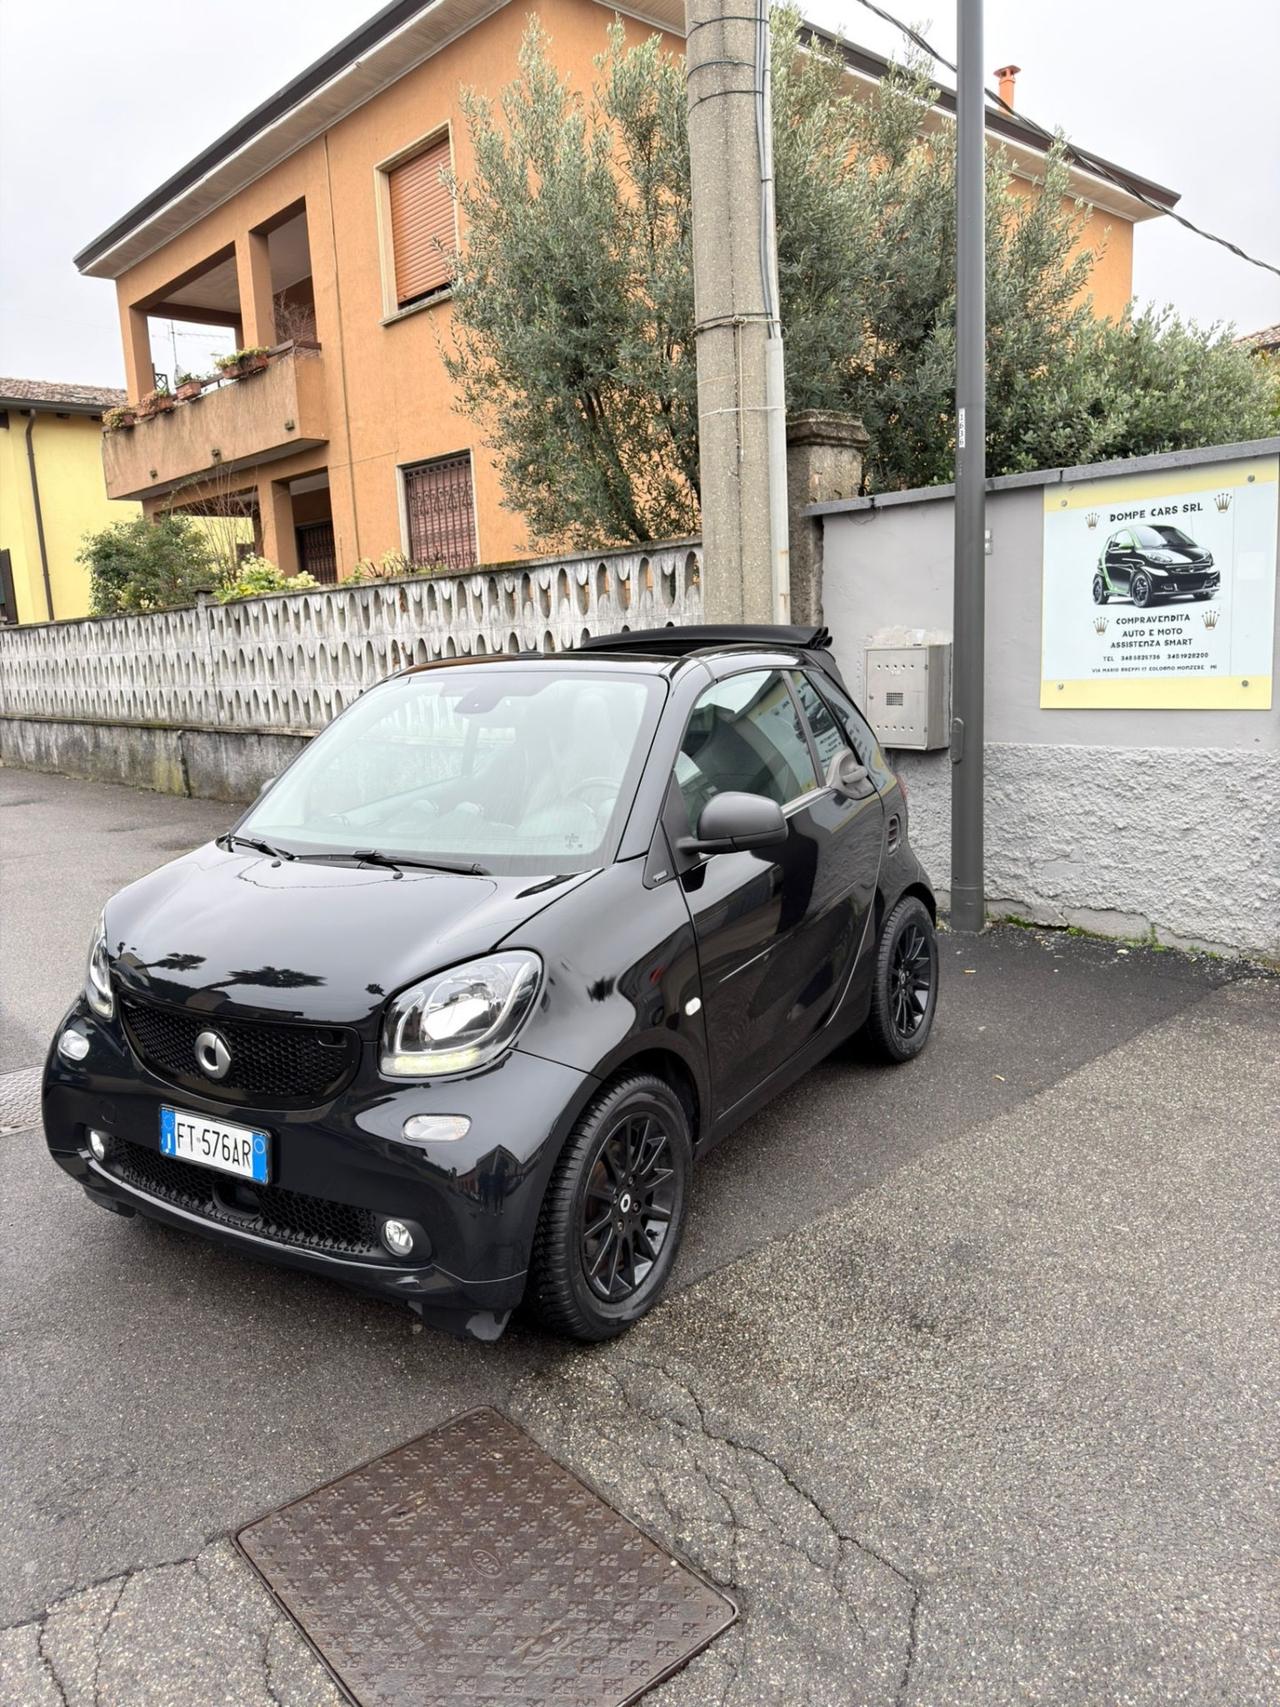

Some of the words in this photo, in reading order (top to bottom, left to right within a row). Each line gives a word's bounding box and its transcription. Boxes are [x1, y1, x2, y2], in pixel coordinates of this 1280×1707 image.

[1110, 510, 1146, 522] DOMPE
[1151, 505, 1178, 517] CARS
[1182, 502, 1204, 512] SRL
[1115, 613, 1191, 625] COMPRAVENDITA
[1122, 630, 1146, 638] AUTO
[1157, 627, 1183, 636] MOTO
[1110, 640, 1161, 649] ASSISTENZA
[1164, 638, 1193, 646] SMART
[176, 1122, 196, 1153] FT
[201, 1128, 252, 1169] 576AR
